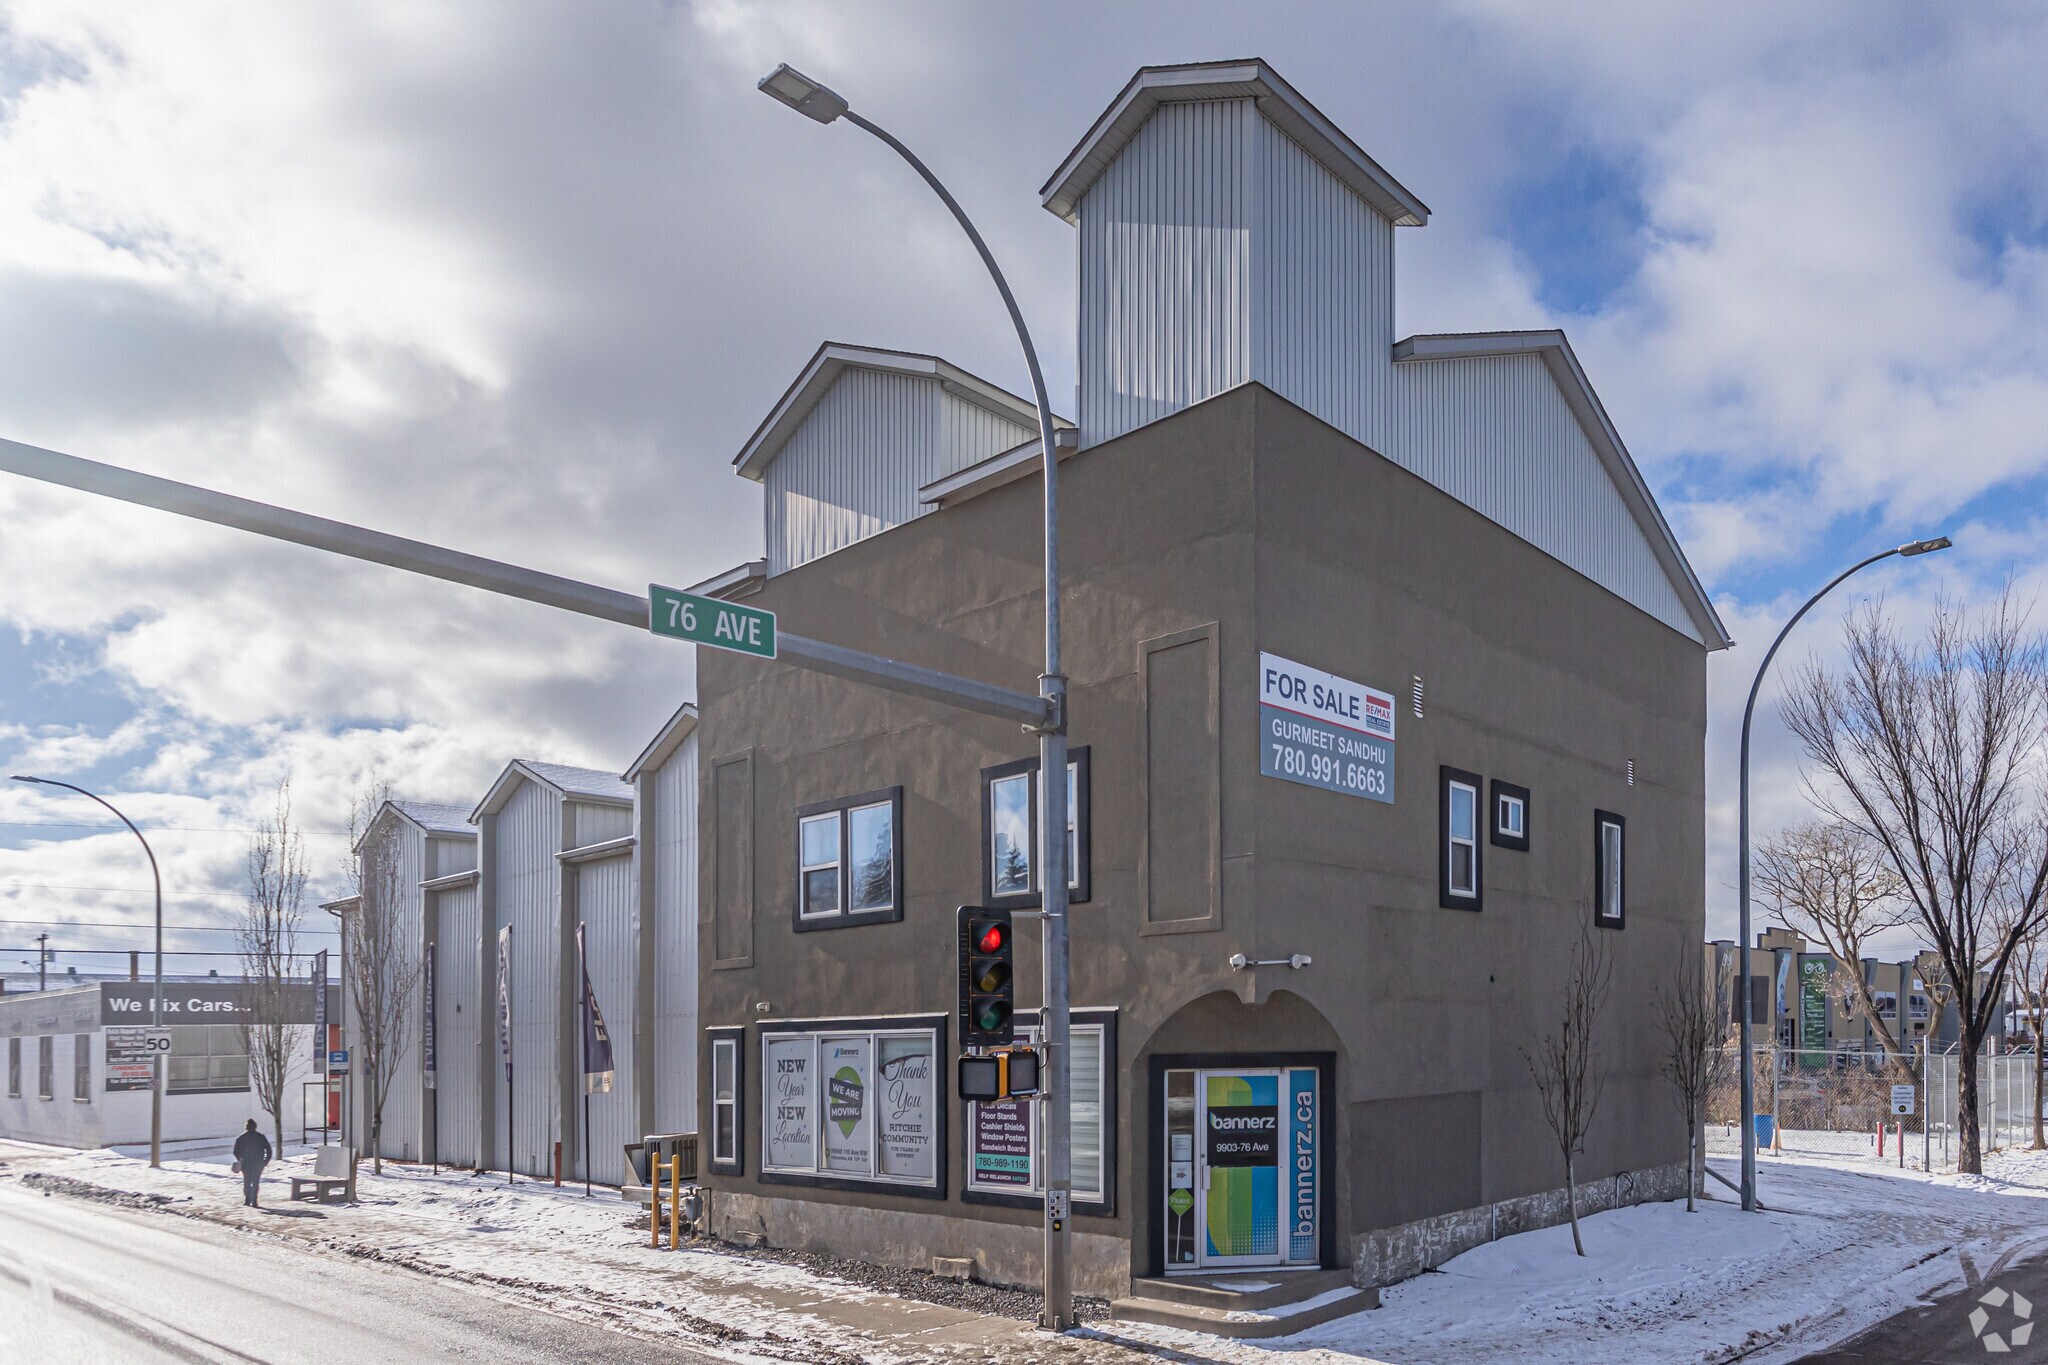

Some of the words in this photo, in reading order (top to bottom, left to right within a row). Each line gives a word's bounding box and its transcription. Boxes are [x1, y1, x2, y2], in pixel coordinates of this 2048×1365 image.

[665, 597, 697, 632] 76
[714, 610, 762, 646] AVE
[1265, 668, 1307, 705] FOR
[1313, 684, 1360, 721] SALE
[1366, 704, 1391, 720] RE/MAX
[1272, 718, 1335, 751] GURMEET
[1338, 736, 1386, 765] SANDHU
[1272, 743, 1386, 795] 780.991.6663
[109, 998, 142, 1012] We
[147, 1038, 170, 1050] 50
[777, 1059, 806, 1073] NEW
[883, 1058, 928, 1081] Thank
[778, 1074, 805, 1105] Year
[832, 1083, 844, 1095] WE
[844, 1087, 860, 1100] ARE
[888, 1079, 922, 1119] You
[777, 1106, 806, 1120] NEW
[831, 1107, 860, 1117] MOVING
[997, 1112, 1017, 1120] Stands
[889, 1124, 921, 1132] RITCHIE
[981, 1122, 1003, 1130] Cashier
[1004, 1123, 1025, 1132] Shields
[1210, 1112, 1275, 1130] bannerz
[772, 1120, 811, 1149] Location
[883, 1134, 929, 1144] COMMUNITY
[981, 1132, 1004, 1141] Window
[1005, 1133, 1027, 1142] Posters
[981, 1143, 1006, 1152] Sandwich
[1007, 1144, 1026, 1153] Boards
[1216, 1142, 1251, 1153] 9903-76
[1252, 1142, 1269, 1152] Ave
[978, 1157, 1029, 1170] 780-989-1190
[1293, 1091, 1314, 1237] bannerz.ca
[989, 1173, 1011, 1181] RELAUNCH
